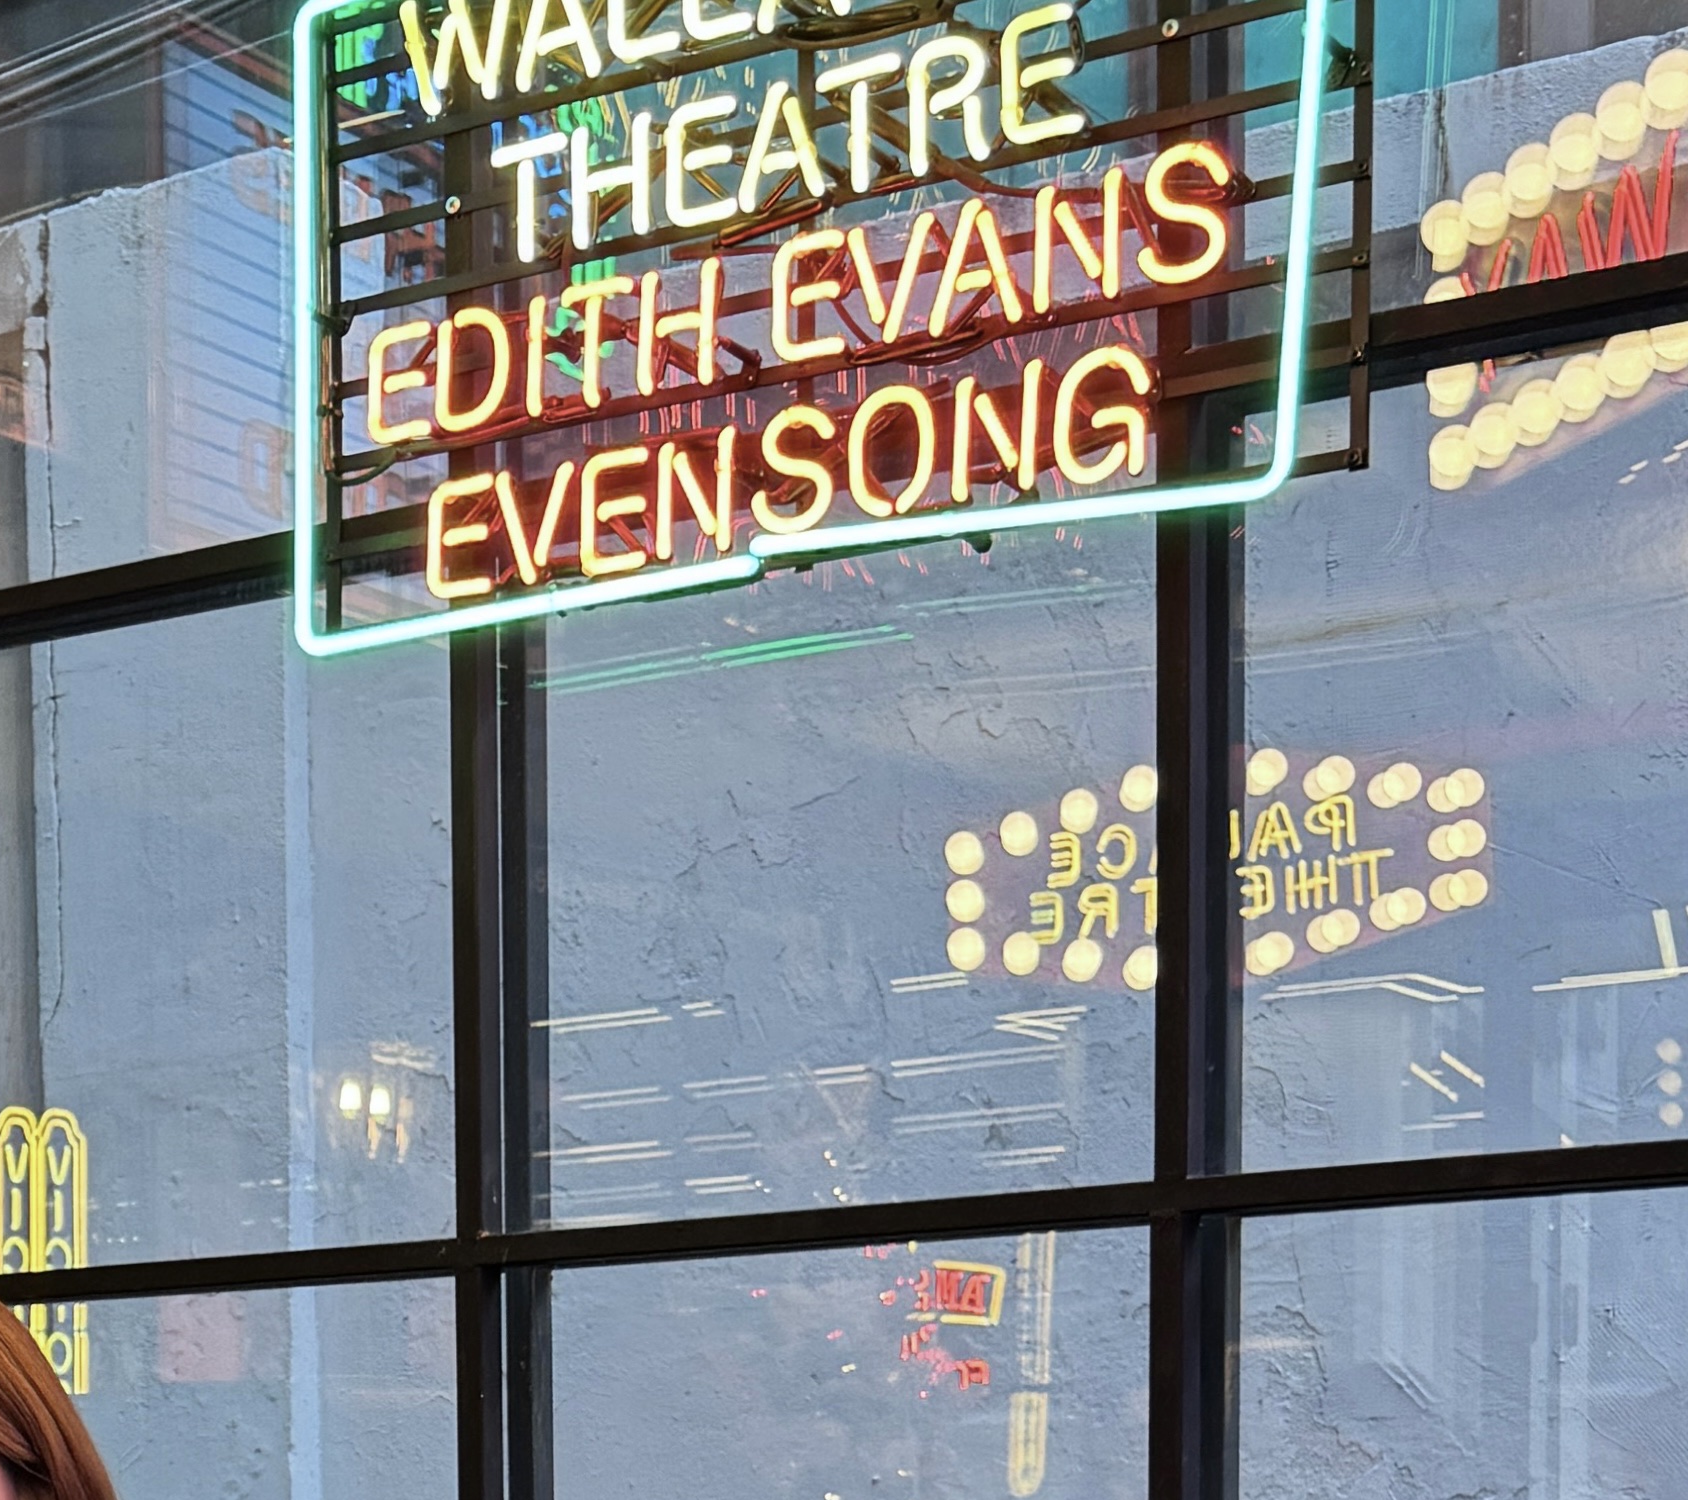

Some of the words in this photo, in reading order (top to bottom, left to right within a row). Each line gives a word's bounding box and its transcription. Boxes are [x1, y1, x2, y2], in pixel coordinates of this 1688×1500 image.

[490, 3, 1090, 264] THEATRE
[366, 256, 722, 446] EDITH
[769, 140, 1232, 362] EVANS
[425, 344, 1153, 600] EVENSONG
